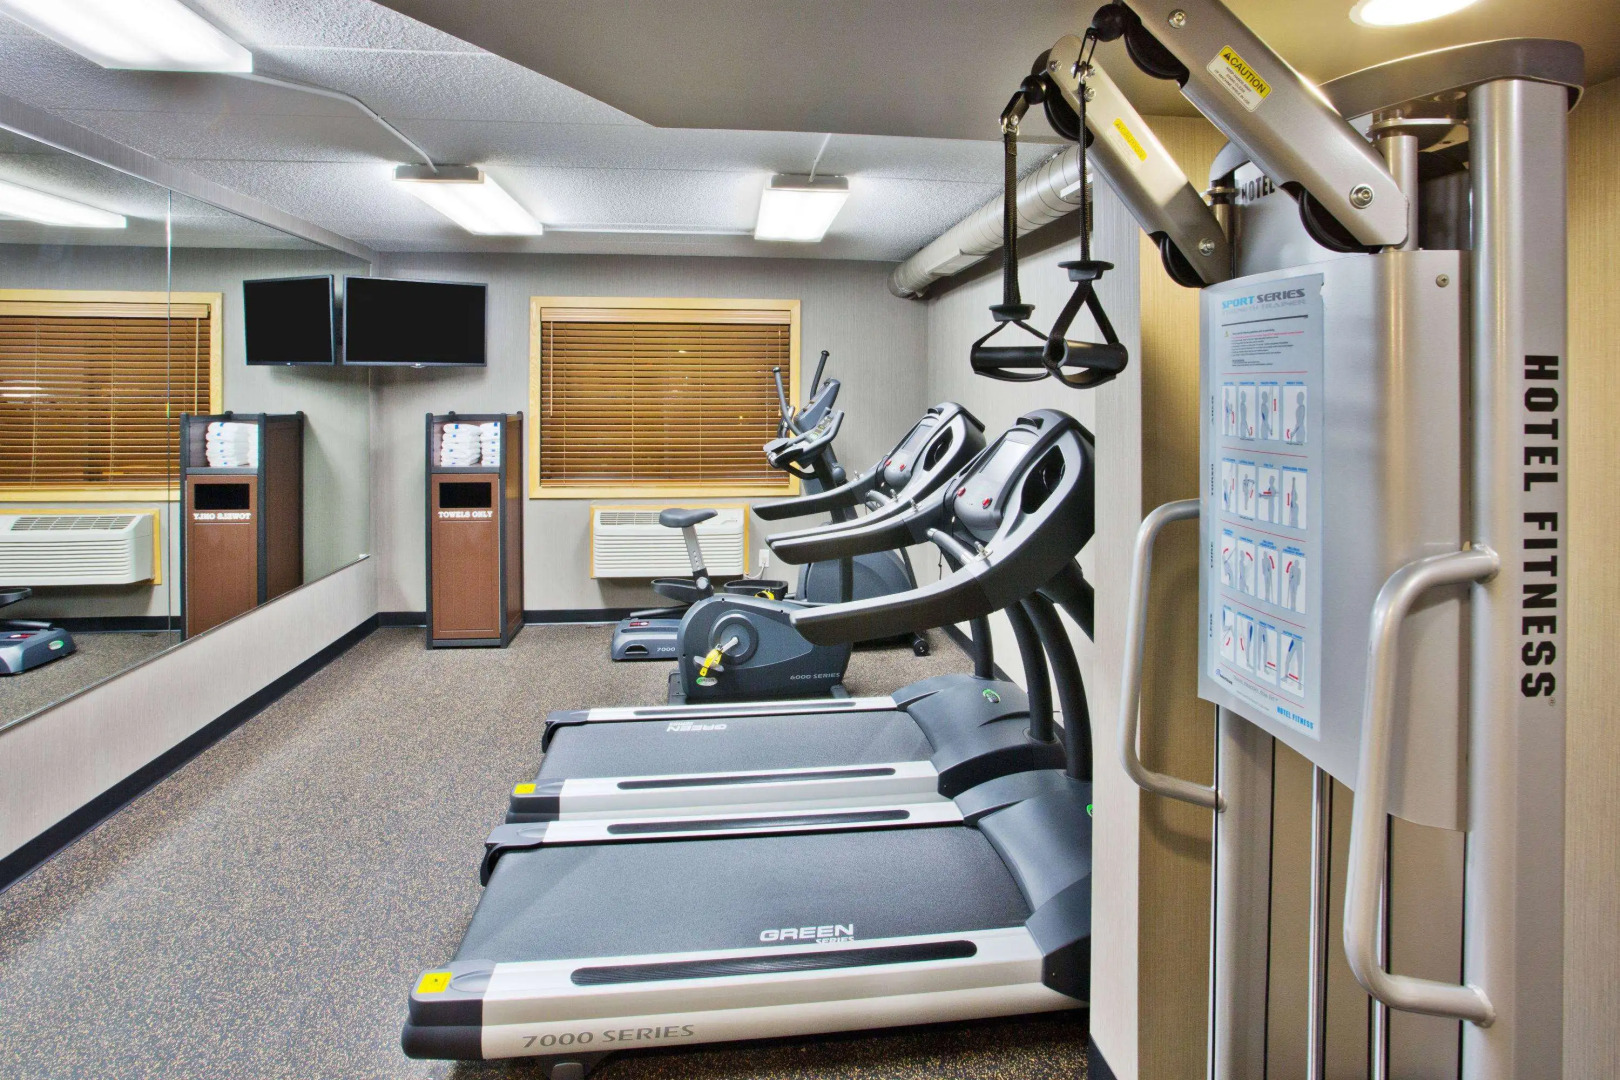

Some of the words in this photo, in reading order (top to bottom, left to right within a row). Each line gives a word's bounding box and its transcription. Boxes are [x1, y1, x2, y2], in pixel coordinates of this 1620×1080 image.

[1230, 57, 1266, 93] CAUTION
[1242, 175, 1275, 201] HOTEL
[1221, 295, 1255, 310] SPORT
[1256, 288, 1306, 304] SERIES
[1524, 355, 1559, 492] HOTEL
[472, 510, 493, 518] ONLY
[1521, 512, 1558, 697] FITNESS
[1276, 705, 1292, 721] HOTEL
[1292, 712, 1314, 731] FITNESS
[759, 924, 854, 942] GREEN
[815, 936, 855, 944] SERIES
[521, 1031, 595, 1049] 7000
[602, 1024, 696, 1043] SERIES
